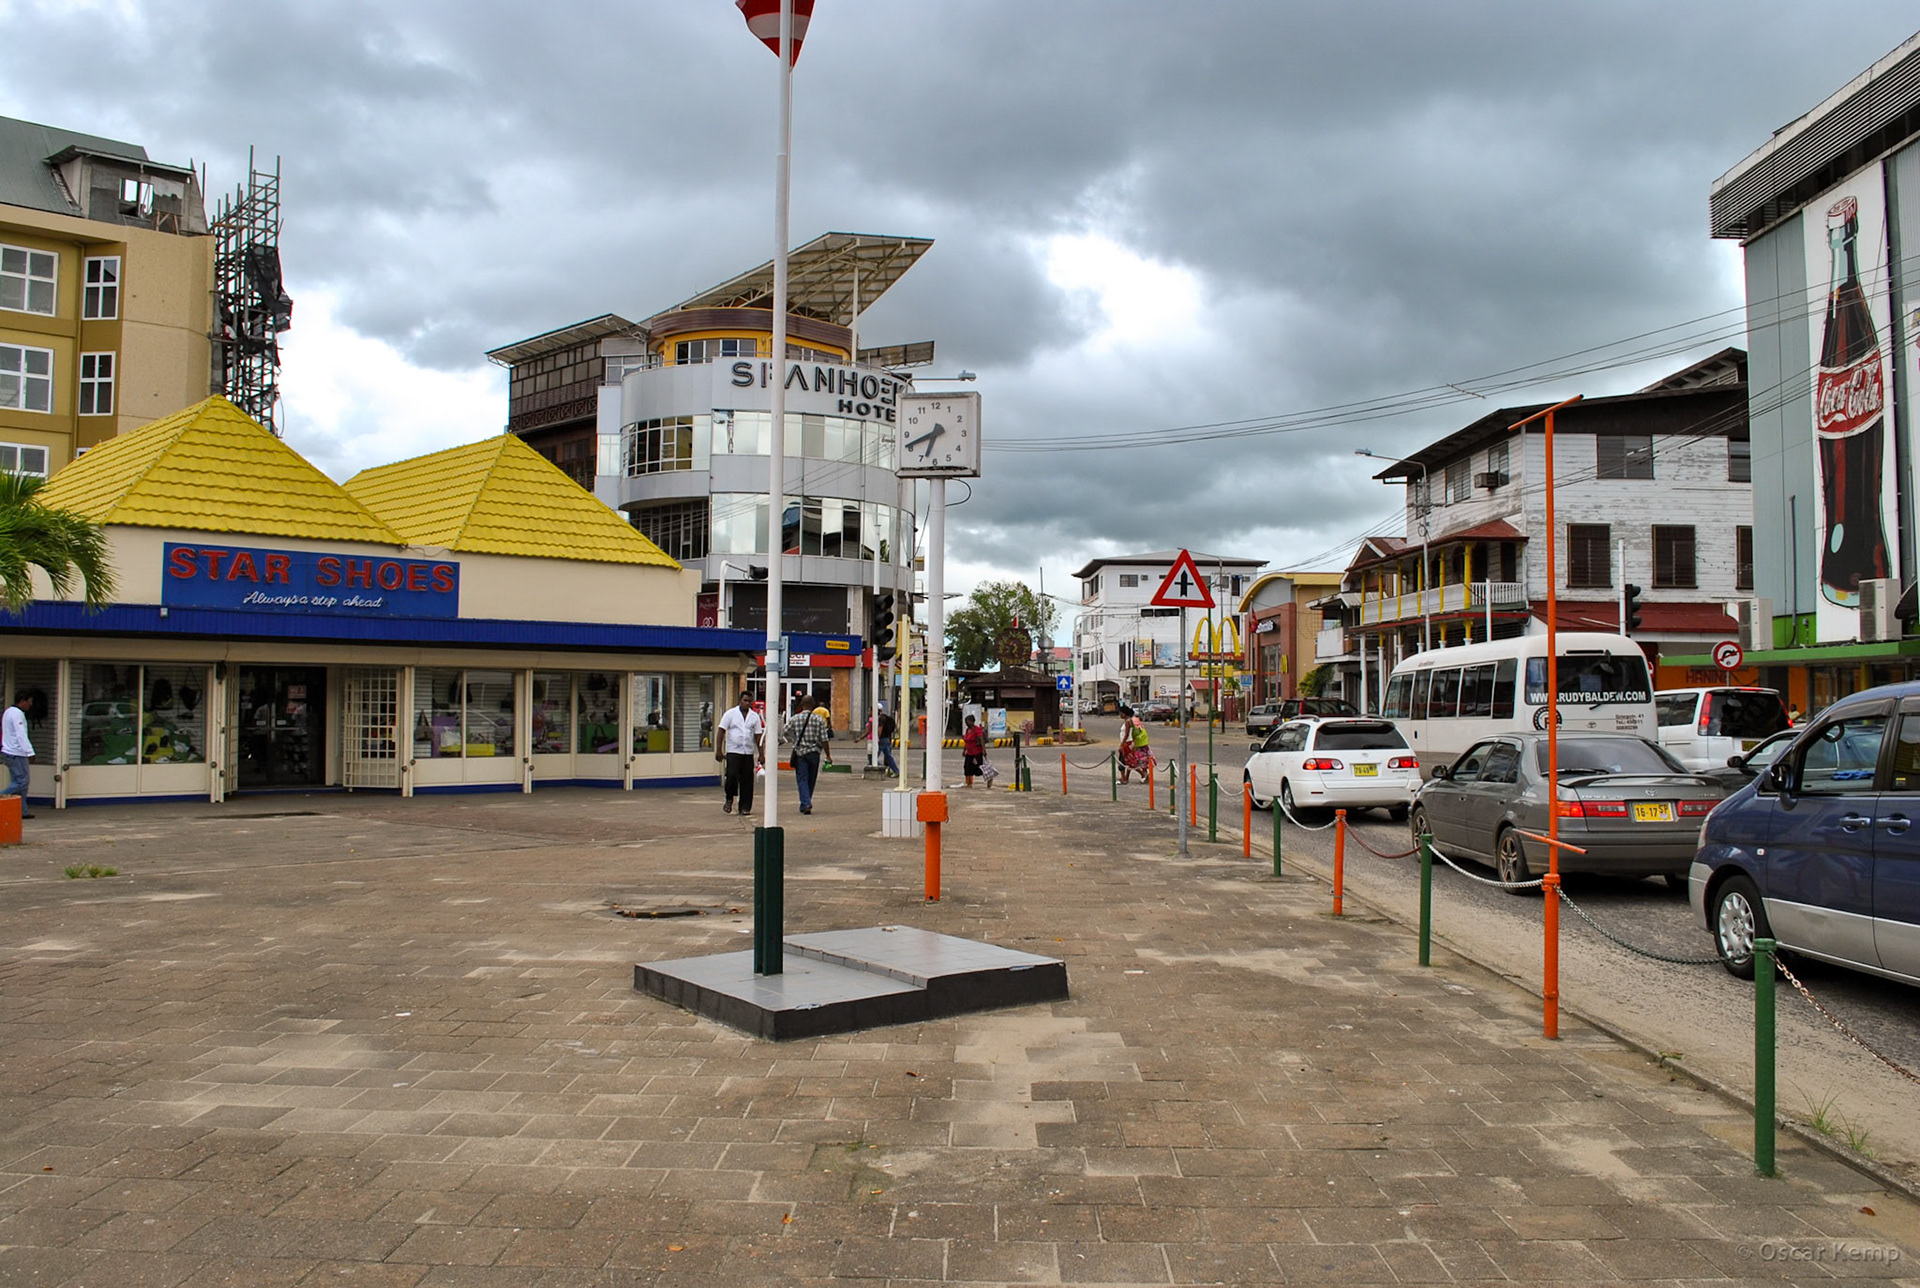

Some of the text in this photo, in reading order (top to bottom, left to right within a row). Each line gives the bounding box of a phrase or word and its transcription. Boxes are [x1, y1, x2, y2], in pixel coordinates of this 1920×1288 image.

[931, 402, 941, 410] 12
[838, 399, 896, 423] HOTE
[956, 415, 963, 423] 2
[955, 444, 961, 452] 4
[932, 458, 938, 466] 6
[945, 454, 952, 462] 5
[169, 547, 455, 592] STAR SHOES
[243, 591, 382, 607] Always a step ahead
[1530, 691, 1647, 703] WW.RUDYBALDEW.COM
[1658, 804, 1668, 814] SP
